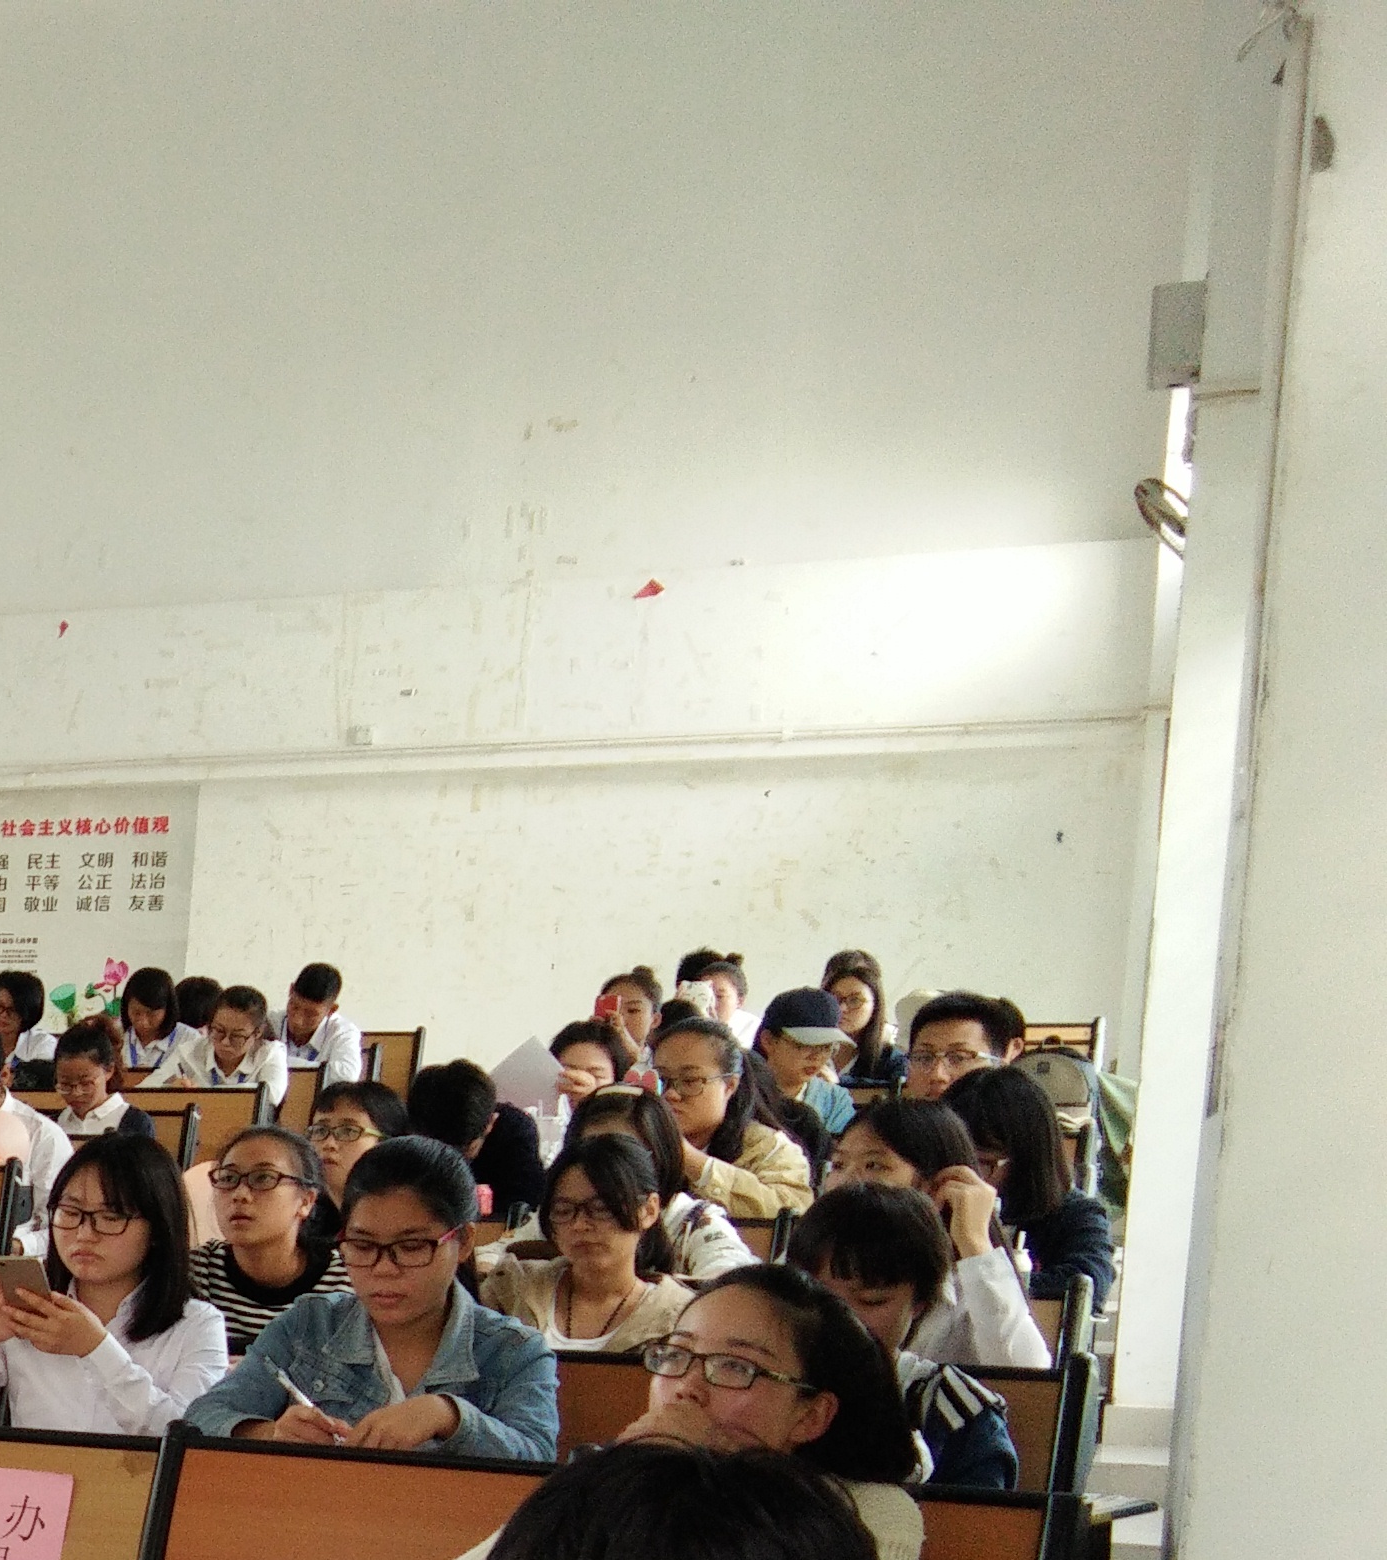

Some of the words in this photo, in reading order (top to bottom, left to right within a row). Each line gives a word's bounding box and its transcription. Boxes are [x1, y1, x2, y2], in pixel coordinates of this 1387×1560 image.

[0, 815, 170, 838] 社会主义核心价值观
[27, 852, 61, 870] 民主
[78, 851, 114, 869] 文明
[132, 850, 168, 868] 和谐
[25, 874, 60, 891] 平等
[78, 873, 113, 891] 公正
[130, 872, 166, 890] 法治
[24, 895, 58, 912] 敬业
[77, 895, 111, 912] 诚信
[129, 894, 165, 911] 友善
